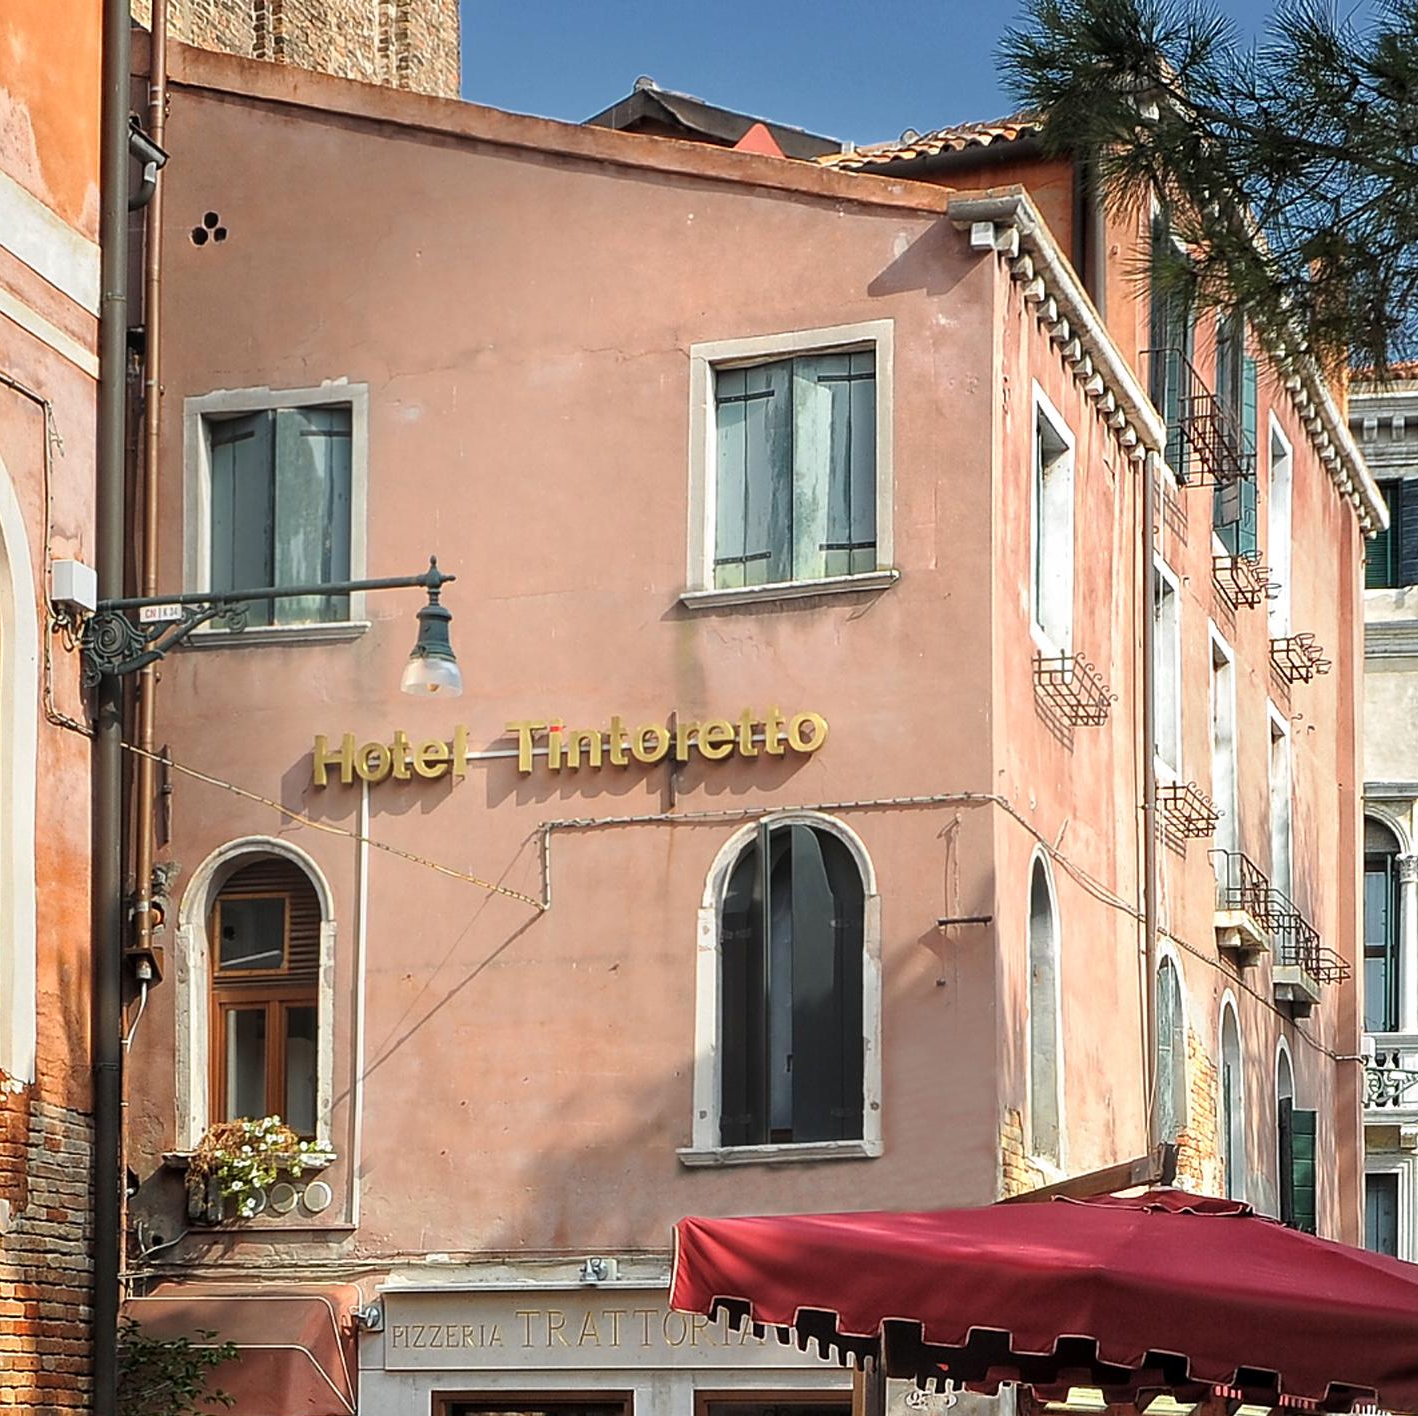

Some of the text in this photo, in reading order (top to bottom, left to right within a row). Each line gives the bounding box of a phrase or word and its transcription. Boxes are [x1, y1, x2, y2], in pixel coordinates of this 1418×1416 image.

[312, 704, 831, 787] Hotel Tintoretto
[391, 1309, 767, 1349] PIZZERIA TRATTORIA
